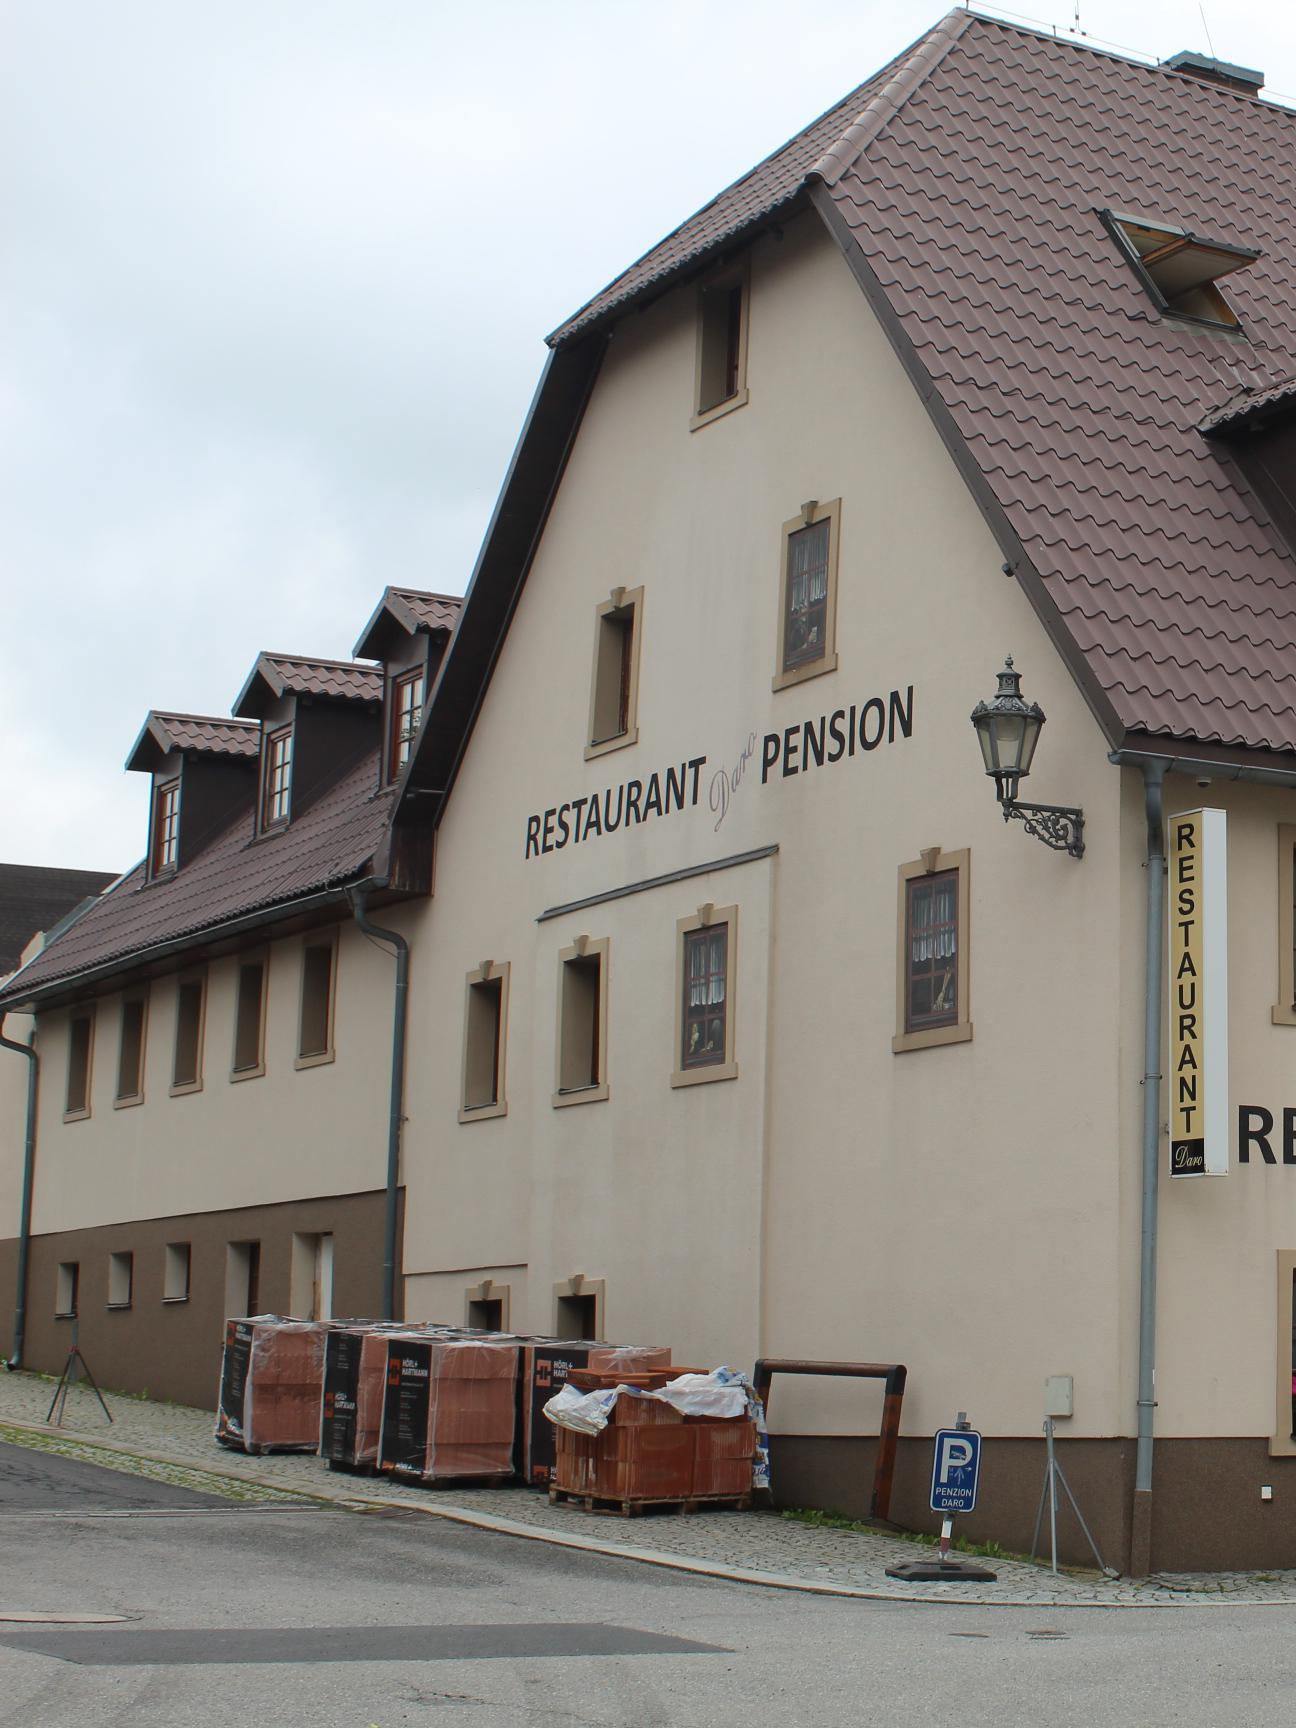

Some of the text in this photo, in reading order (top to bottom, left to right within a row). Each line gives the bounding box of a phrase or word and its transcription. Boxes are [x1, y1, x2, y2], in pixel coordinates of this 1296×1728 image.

[525, 685, 914, 860] RESTAURANT Daro PENSION
[1176, 823, 1198, 1134] RESTAURANT
[1175, 1145, 1203, 1168] Daro
[939, 1437, 973, 1483] P
[936, 1487, 972, 1497] PENZION
[941, 1499, 964, 1507] DARO
